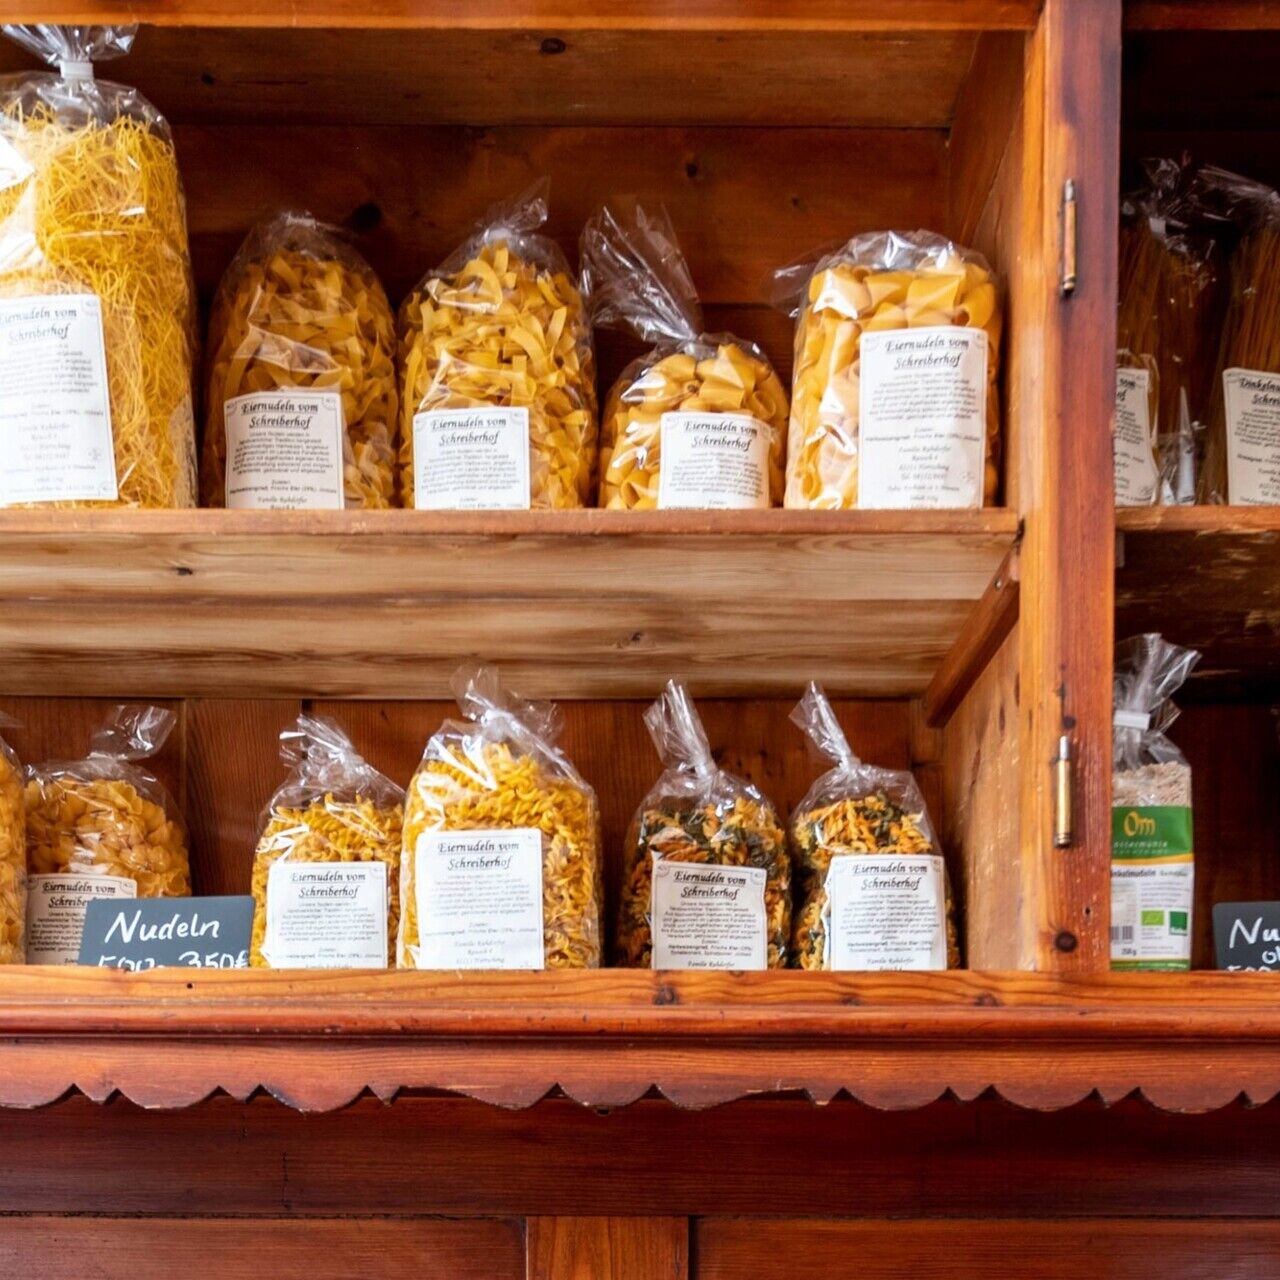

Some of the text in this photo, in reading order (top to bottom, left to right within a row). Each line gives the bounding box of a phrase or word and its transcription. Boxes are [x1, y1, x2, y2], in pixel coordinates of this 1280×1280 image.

[55, 308, 78, 318] vom
[885, 337, 970, 352] Eiernudeln vom
[894, 352, 962, 370] Schreiberhof
[241, 400, 319, 415] Eiernudeln vom
[249, 414, 313, 430] Schreiberhof
[432, 416, 507, 430] Eiernudeln vom
[684, 420, 738, 432] Eiernudeln
[439, 430, 500, 447] Schreiberhof
[691, 435, 753, 452] Schreiberhof
[1124, 811, 1156, 837] Om
[438, 840, 519, 853] Eiernudeln vom
[447, 856, 513, 871] Schreiberhof
[853, 862, 928, 875] Eiernudeln vom
[291, 870, 366, 882] Eiernudeln vom
[674, 870, 747, 885] Eiernudeln vom
[42, 880, 116, 894] Eiernudeln vom
[861, 877, 921, 891] Schreiberhof
[299, 885, 361, 899] Schreiberhof
[680, 885, 739, 901] Schreiberhof
[104, 909, 221, 944] Nudeln
